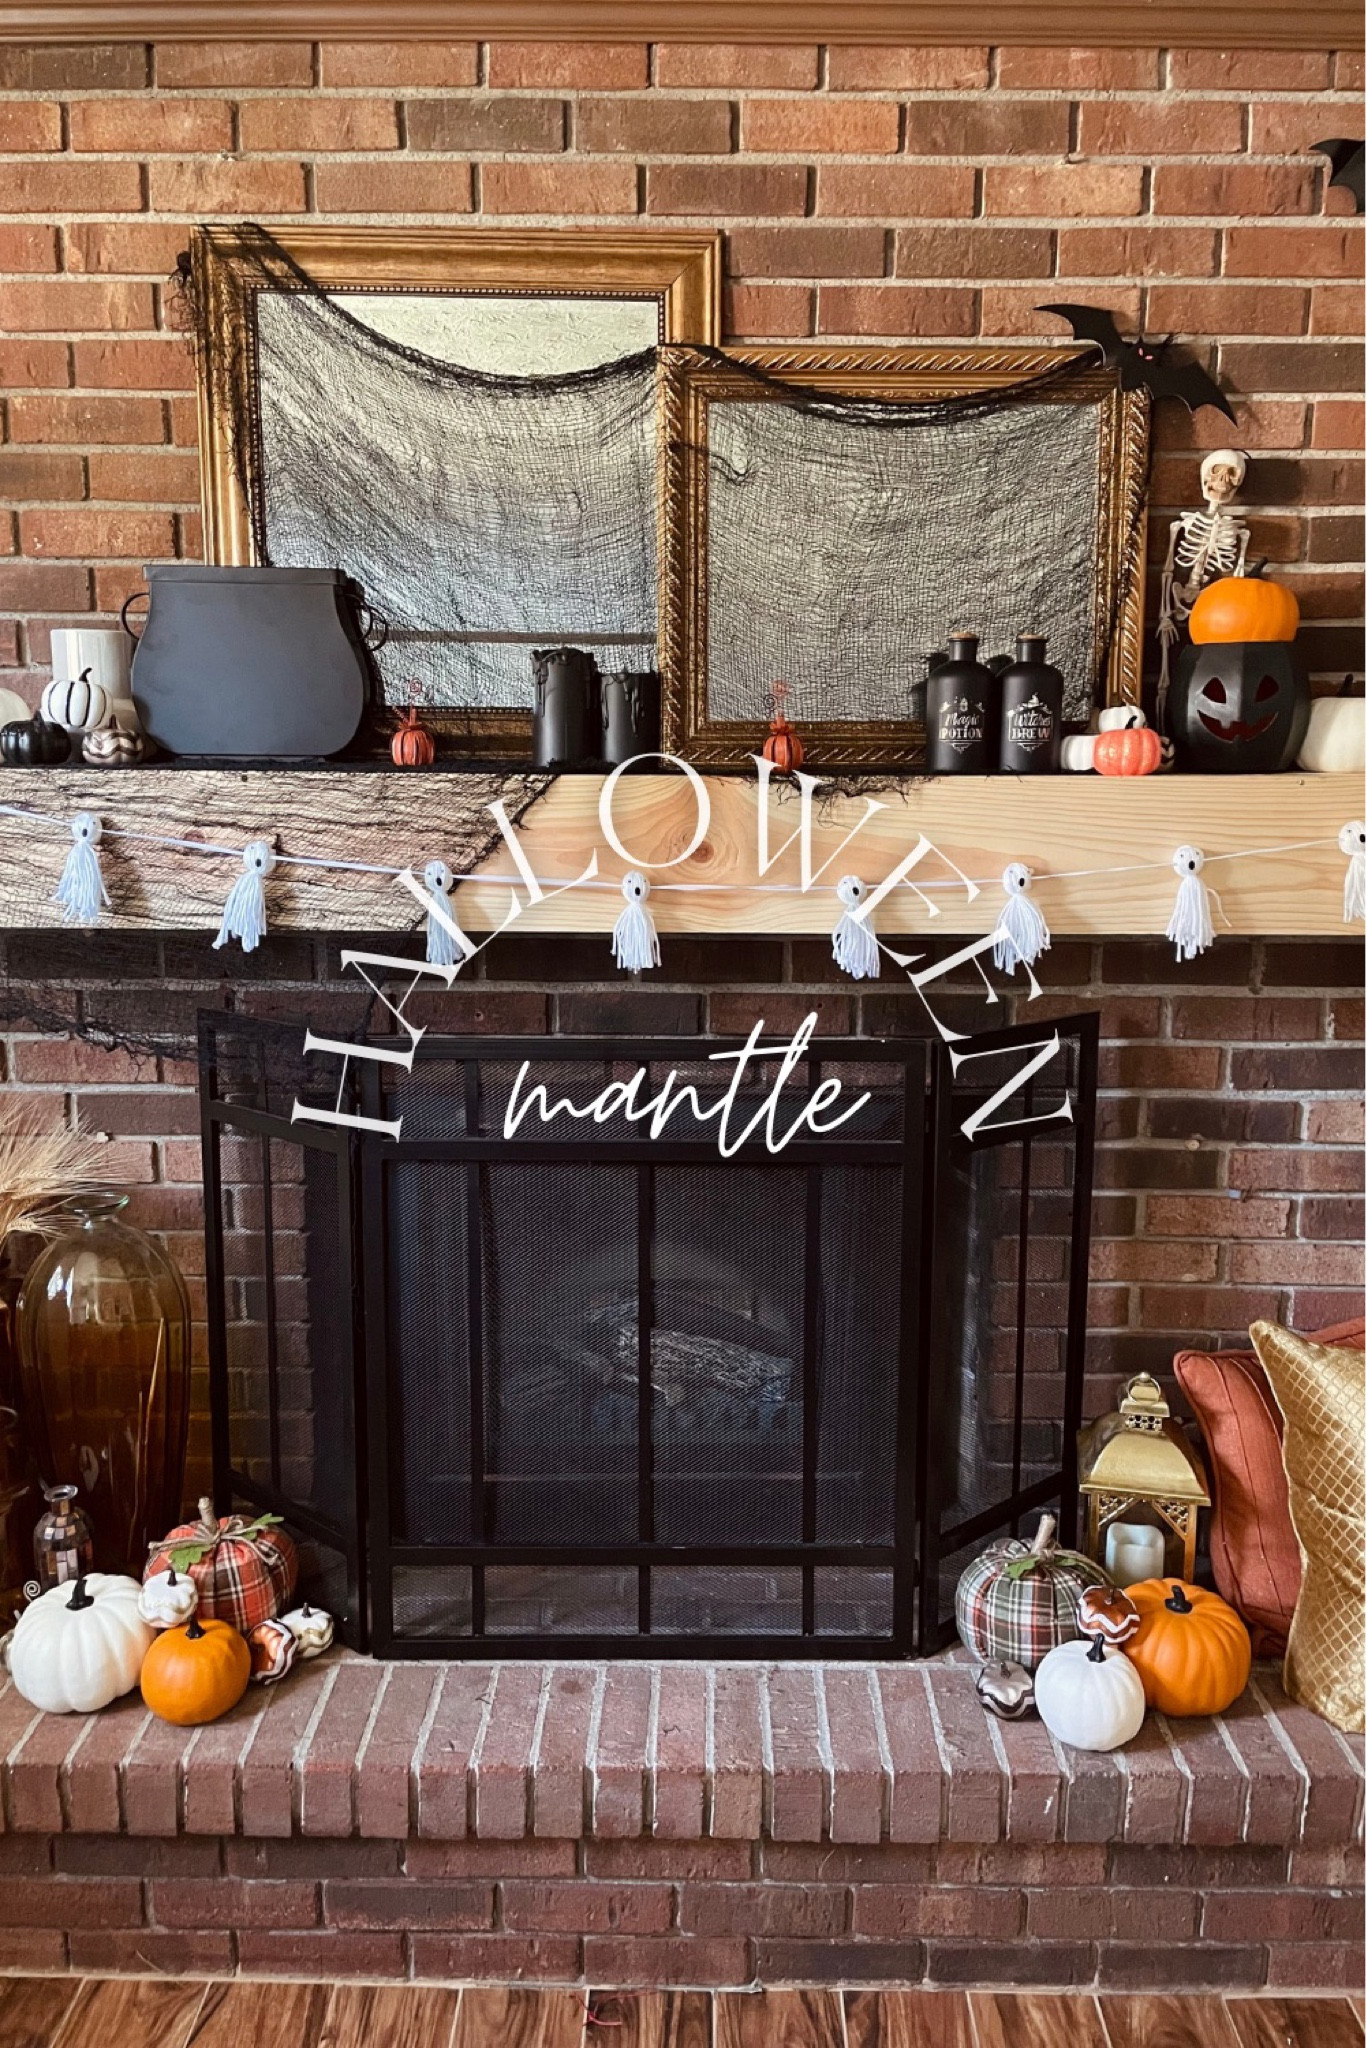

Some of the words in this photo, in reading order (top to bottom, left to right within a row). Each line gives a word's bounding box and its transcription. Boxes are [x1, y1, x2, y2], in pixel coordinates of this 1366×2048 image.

[945, 713, 979, 729] Magic
[941, 728, 982, 739] POTION
[1011, 728, 1049, 739] BREW
